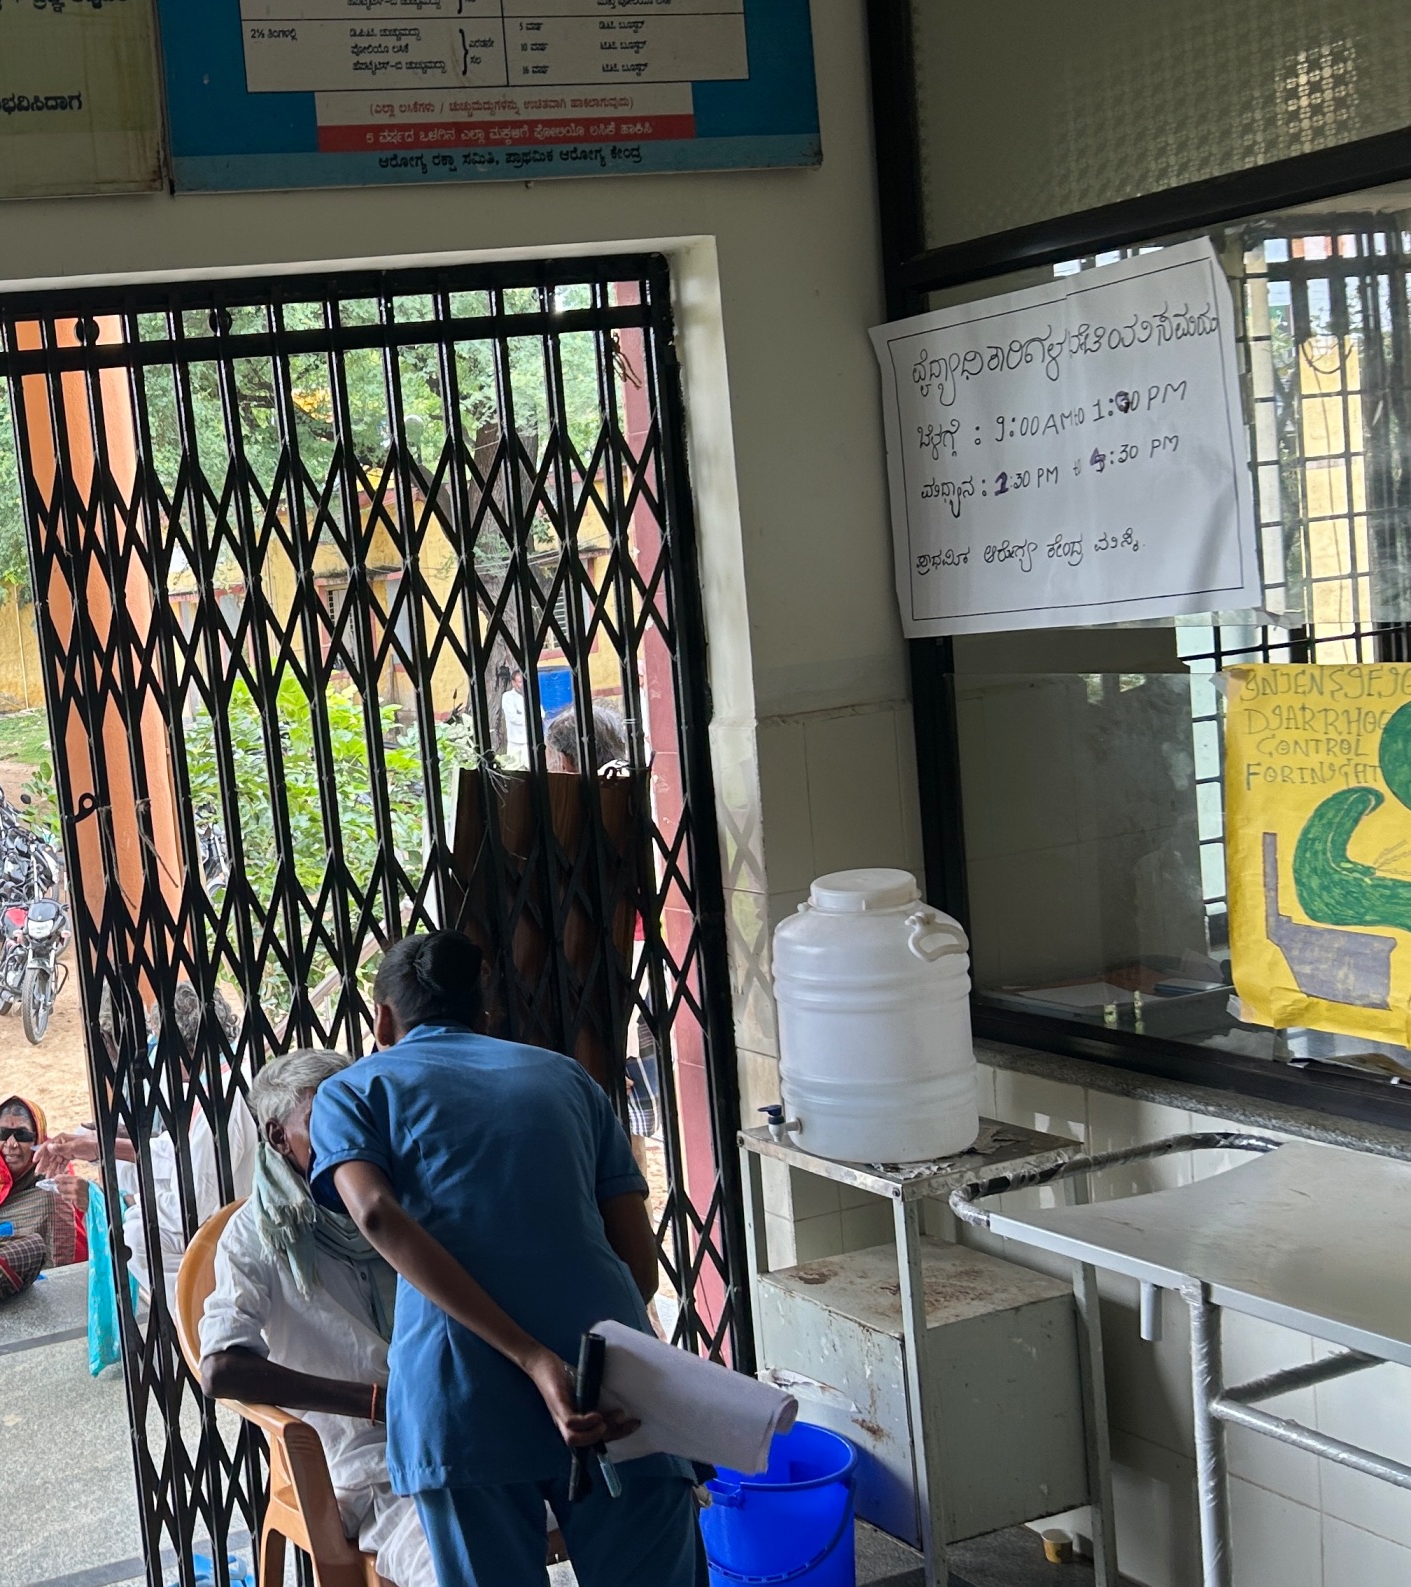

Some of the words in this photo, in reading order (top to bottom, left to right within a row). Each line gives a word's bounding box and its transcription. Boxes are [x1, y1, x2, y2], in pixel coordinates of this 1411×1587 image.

[366, 133, 374, 143] 5
[378, 153, 428, 174] ಆರೋಗ್ಯ
[559, 147, 607, 167] ಆರೋಗ್ಯ
[610, 145, 643, 163] ಕೇಂದ್ರ
[1147, 380, 1188, 412] PM
[1037, 466, 1059, 489] PM
[1150, 435, 1179, 459] PM
[1257, 734, 1371, 758] CONTROL
